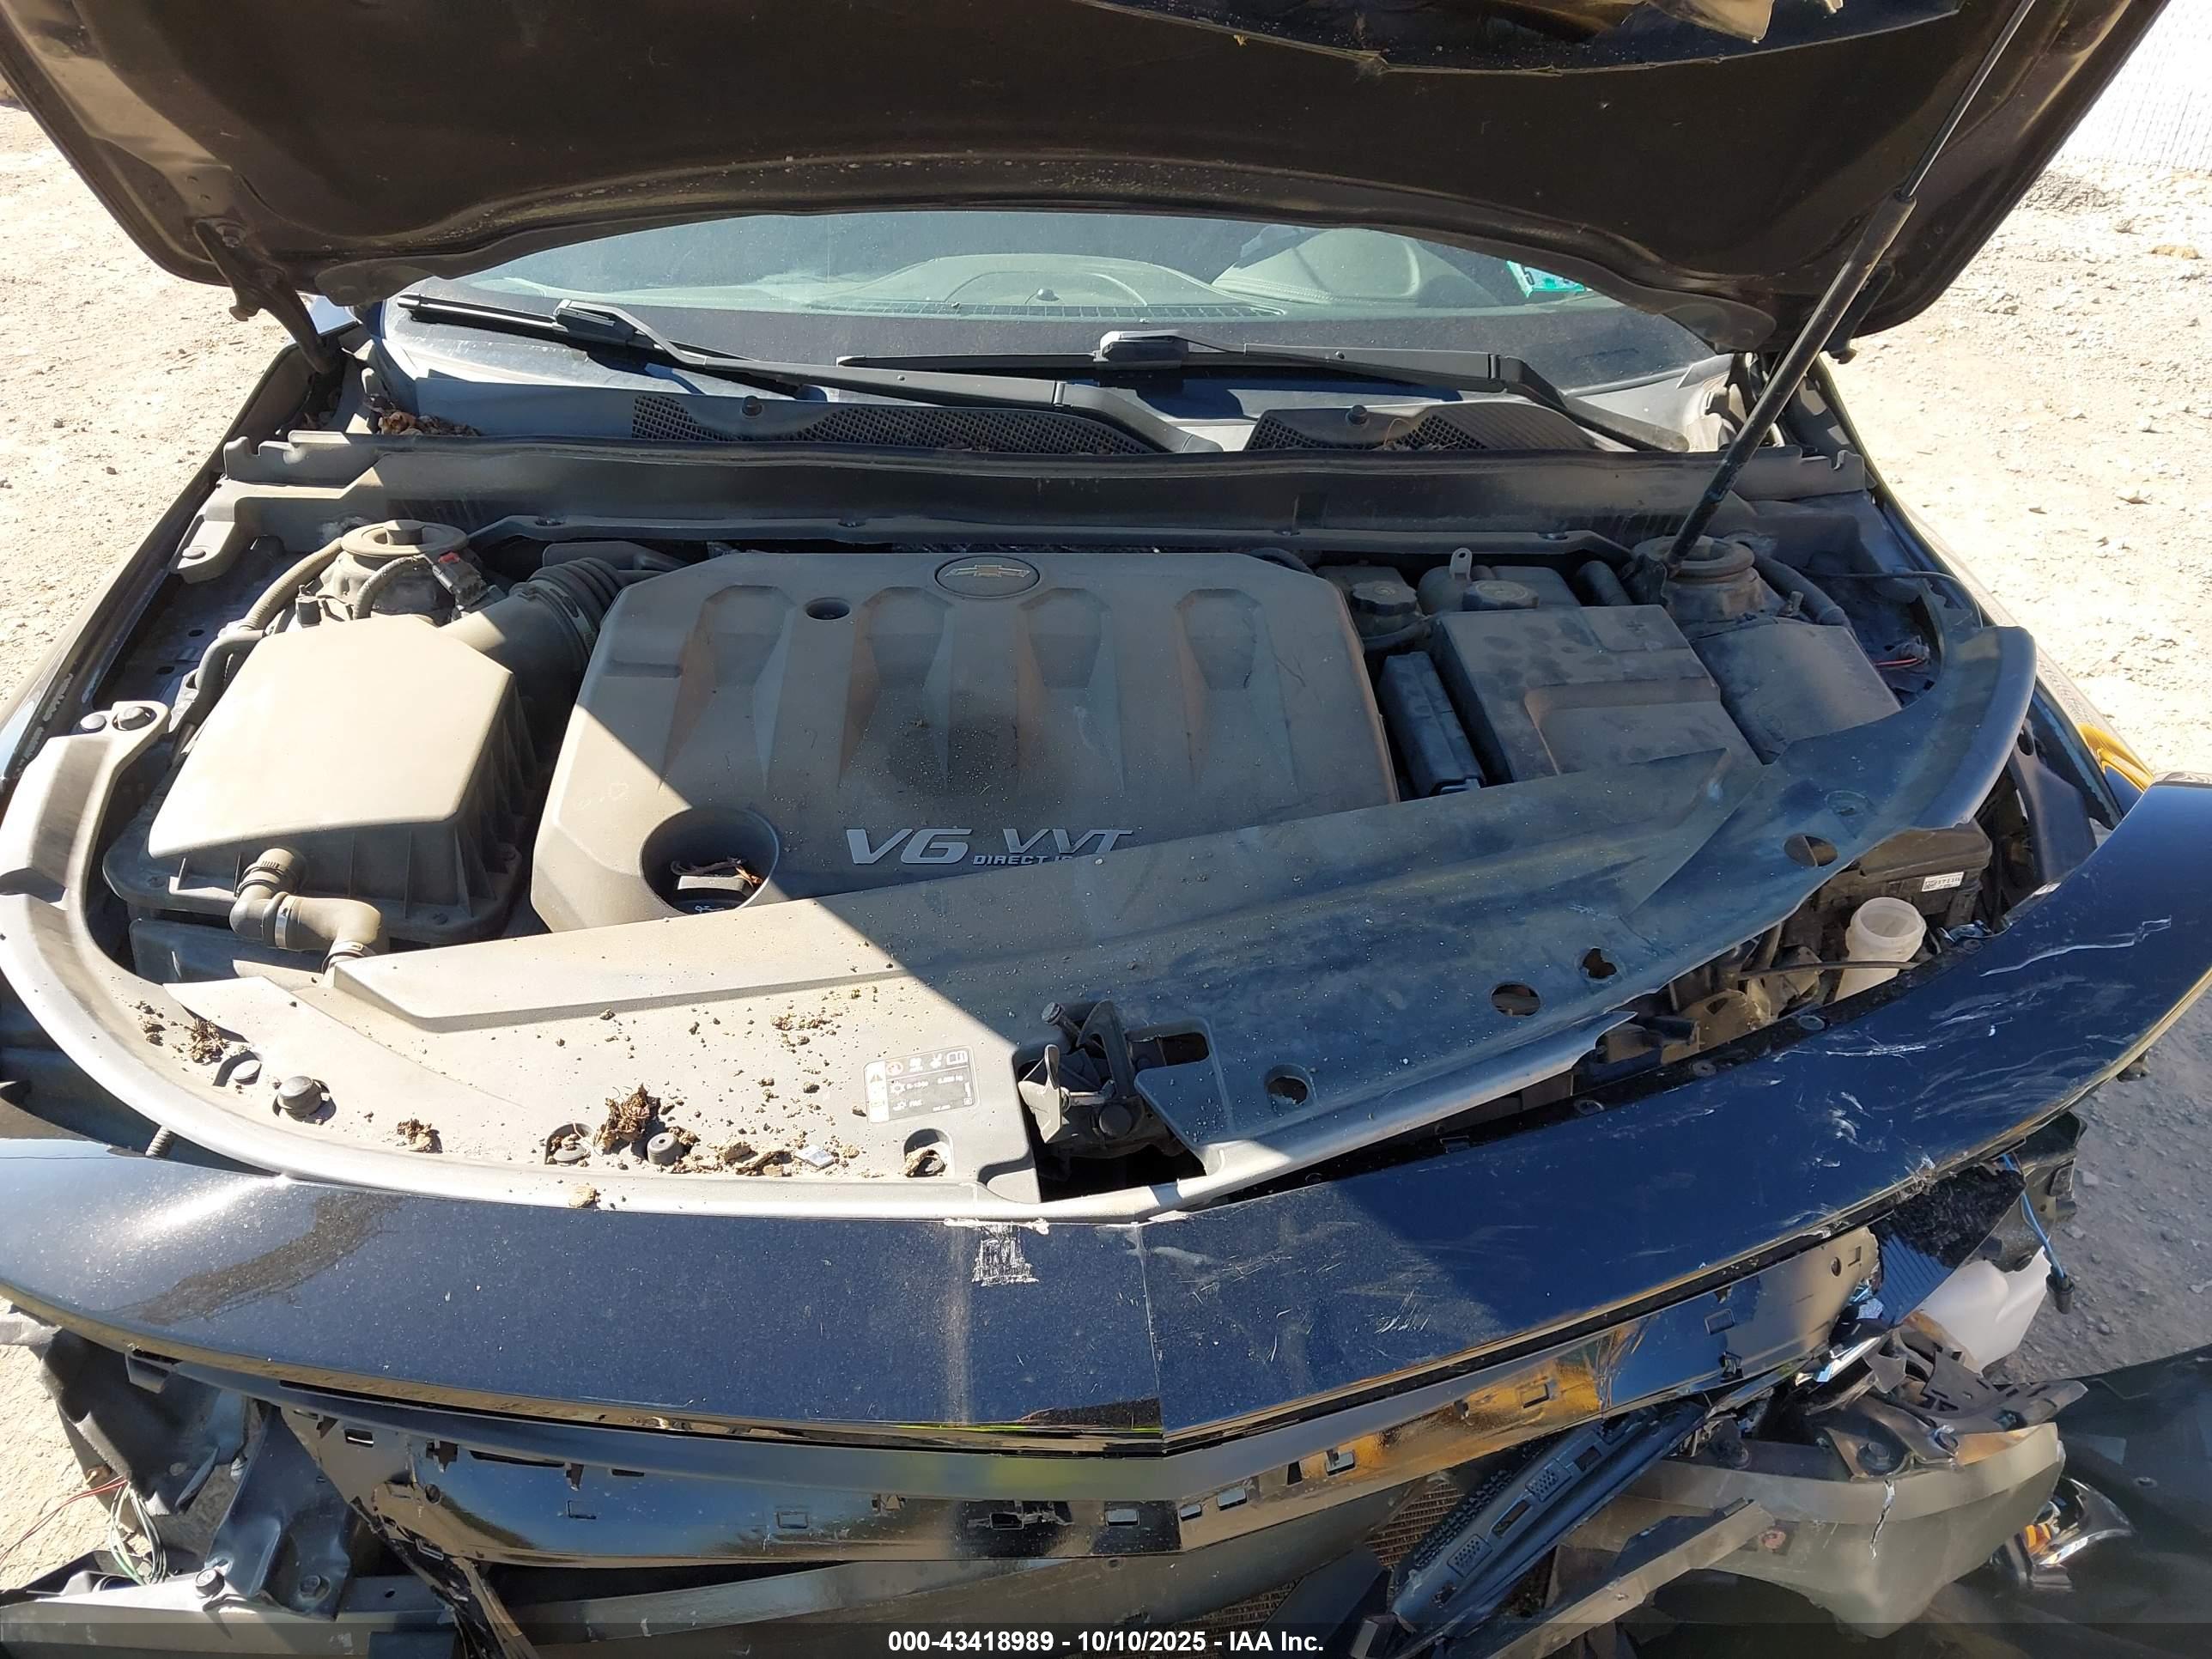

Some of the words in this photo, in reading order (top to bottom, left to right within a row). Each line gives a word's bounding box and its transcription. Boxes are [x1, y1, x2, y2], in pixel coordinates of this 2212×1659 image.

[846, 828, 972, 865] V6
[1002, 828, 1133, 854] VVT
[972, 855, 1048, 866] DIRECT
